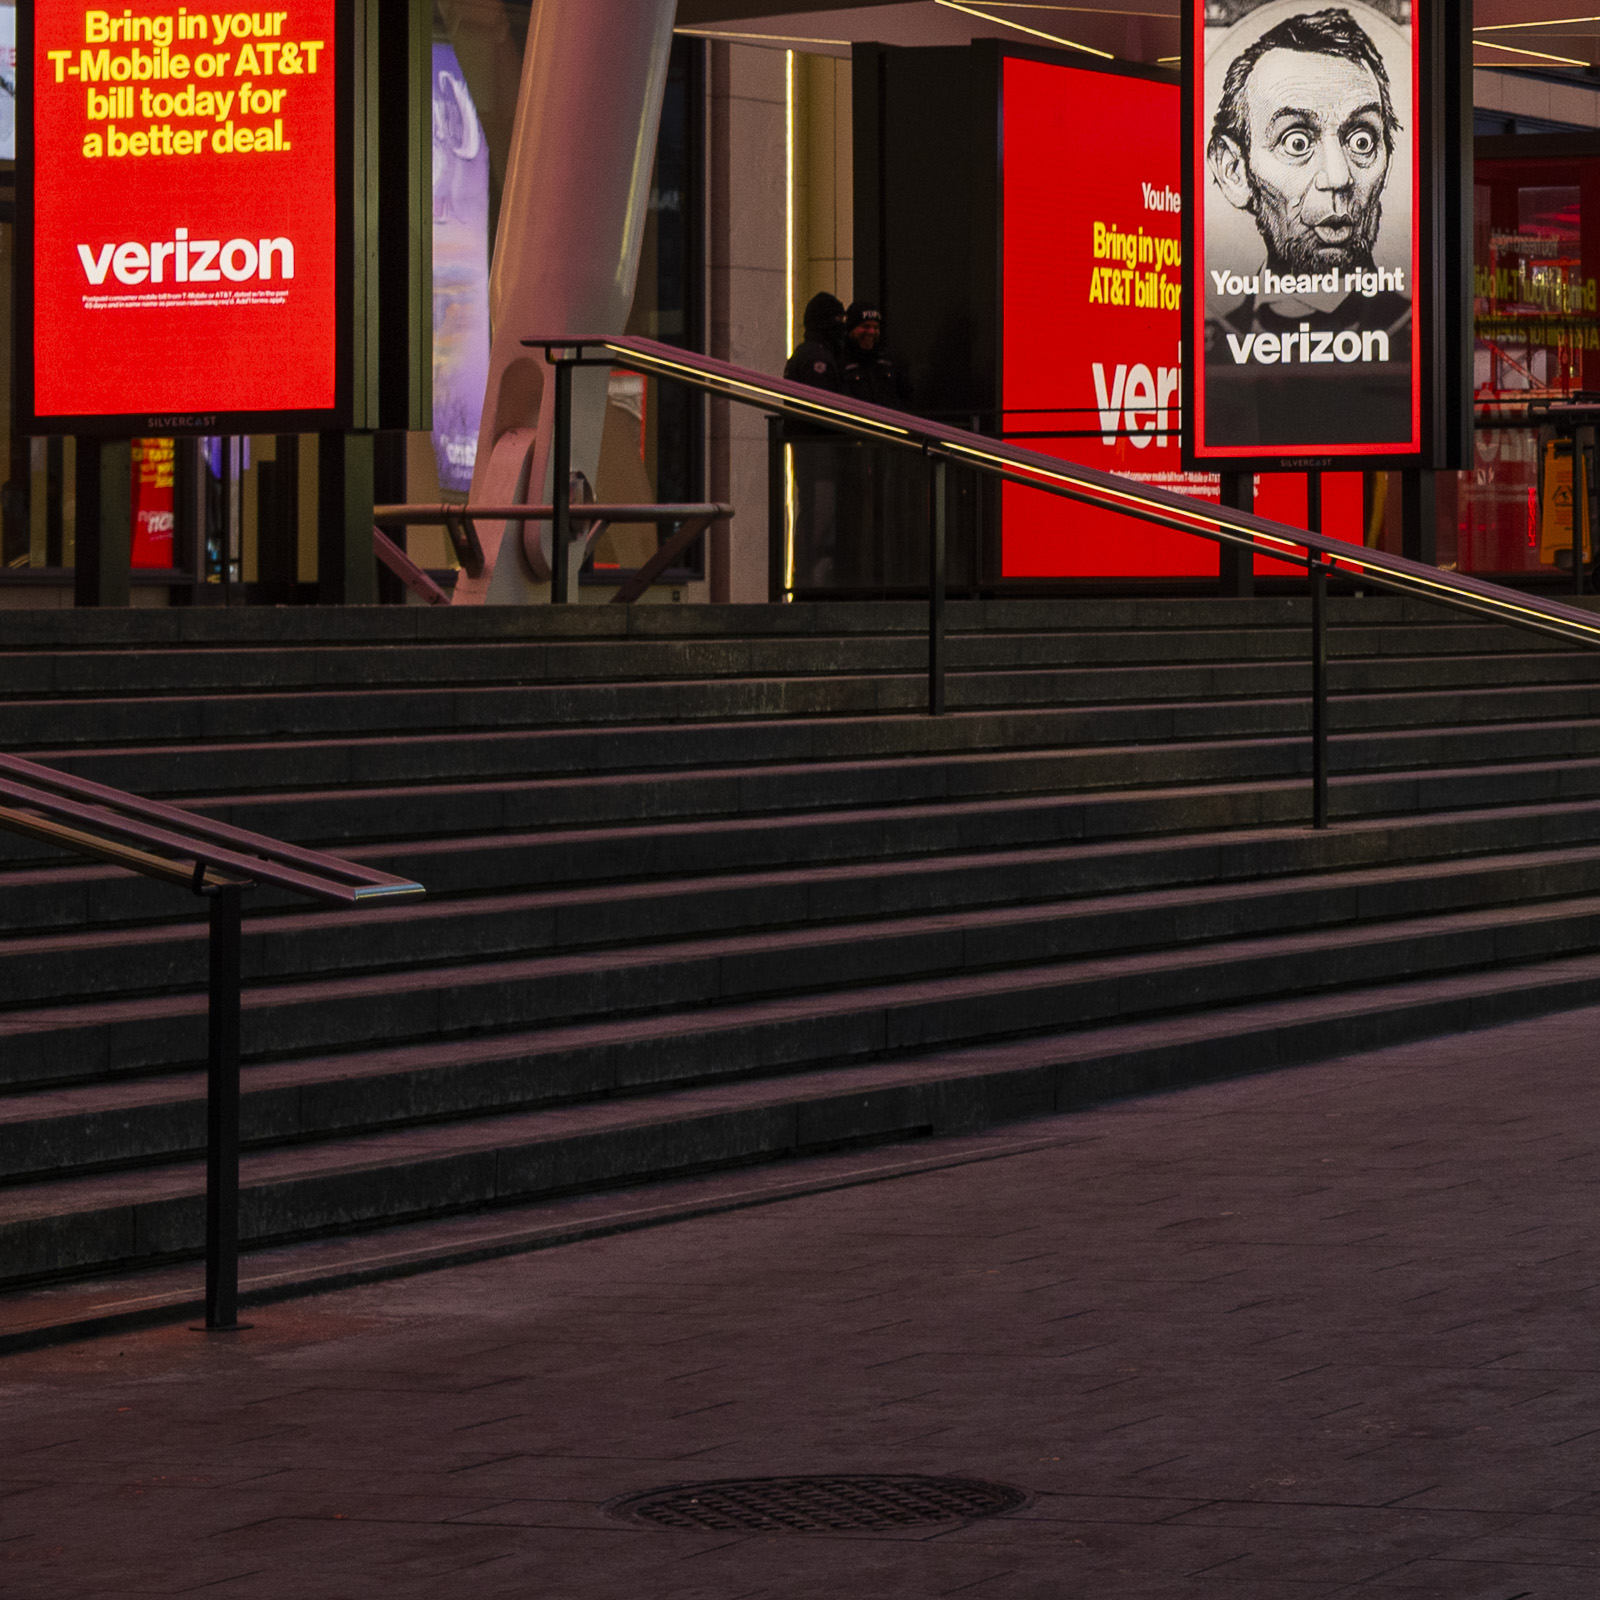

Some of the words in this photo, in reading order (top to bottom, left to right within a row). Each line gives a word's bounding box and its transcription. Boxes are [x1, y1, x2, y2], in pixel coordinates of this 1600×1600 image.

[85, 9, 174, 47] Bring
[178, 7, 207, 40] in
[211, 10, 287, 45] your
[48, 47, 190, 83] T-Mobile
[194, 52, 230, 79] or
[234, 40, 324, 77] AT&T
[87, 86, 134, 120] bill
[140, 83, 235, 122] today
[238, 81, 287, 114] for
[82, 132, 103, 158] a
[107, 124, 208, 157] better
[211, 119, 291, 154] deal.
[1141, 181, 1164, 211] You
[77, 227, 295, 285] verizon
[1093, 221, 1137, 270] Bring
[1138, 226, 1153, 264] in
[1154, 237, 1181, 272] you
[1089, 266, 1134, 307] AT&T
[1135, 270, 1158, 308] bill
[1159, 273, 1181, 310] for
[1210, 269, 1260, 296] You
[1264, 267, 1339, 294] heard
[1344, 266, 1405, 298] right
[1226, 322, 1390, 365] verizon
[148, 415, 217, 428] SILVERCAST
